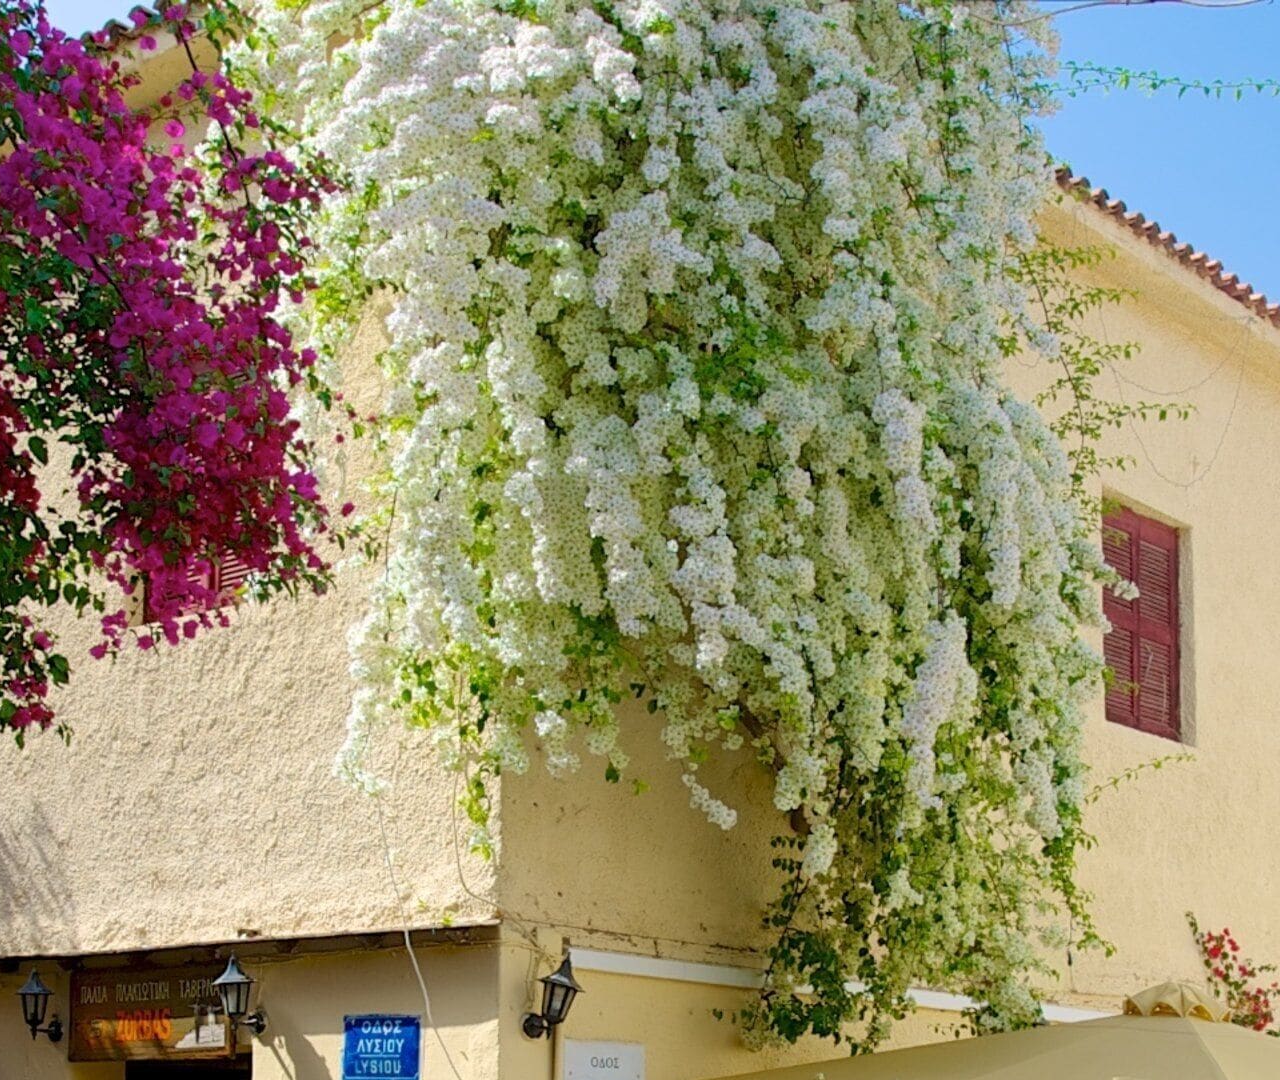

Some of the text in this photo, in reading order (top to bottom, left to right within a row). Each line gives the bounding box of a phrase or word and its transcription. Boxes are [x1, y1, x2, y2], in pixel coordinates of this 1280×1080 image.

[116, 1008, 172, 1041] ZORBAS
[361, 1020, 402, 1035] ΟΔΟΣ
[357, 1039, 404, 1053] ΛΥΣΙΟΥ
[355, 1060, 401, 1074] LYSIOU
[590, 1056, 620, 1069] ΟΔΟΣ
